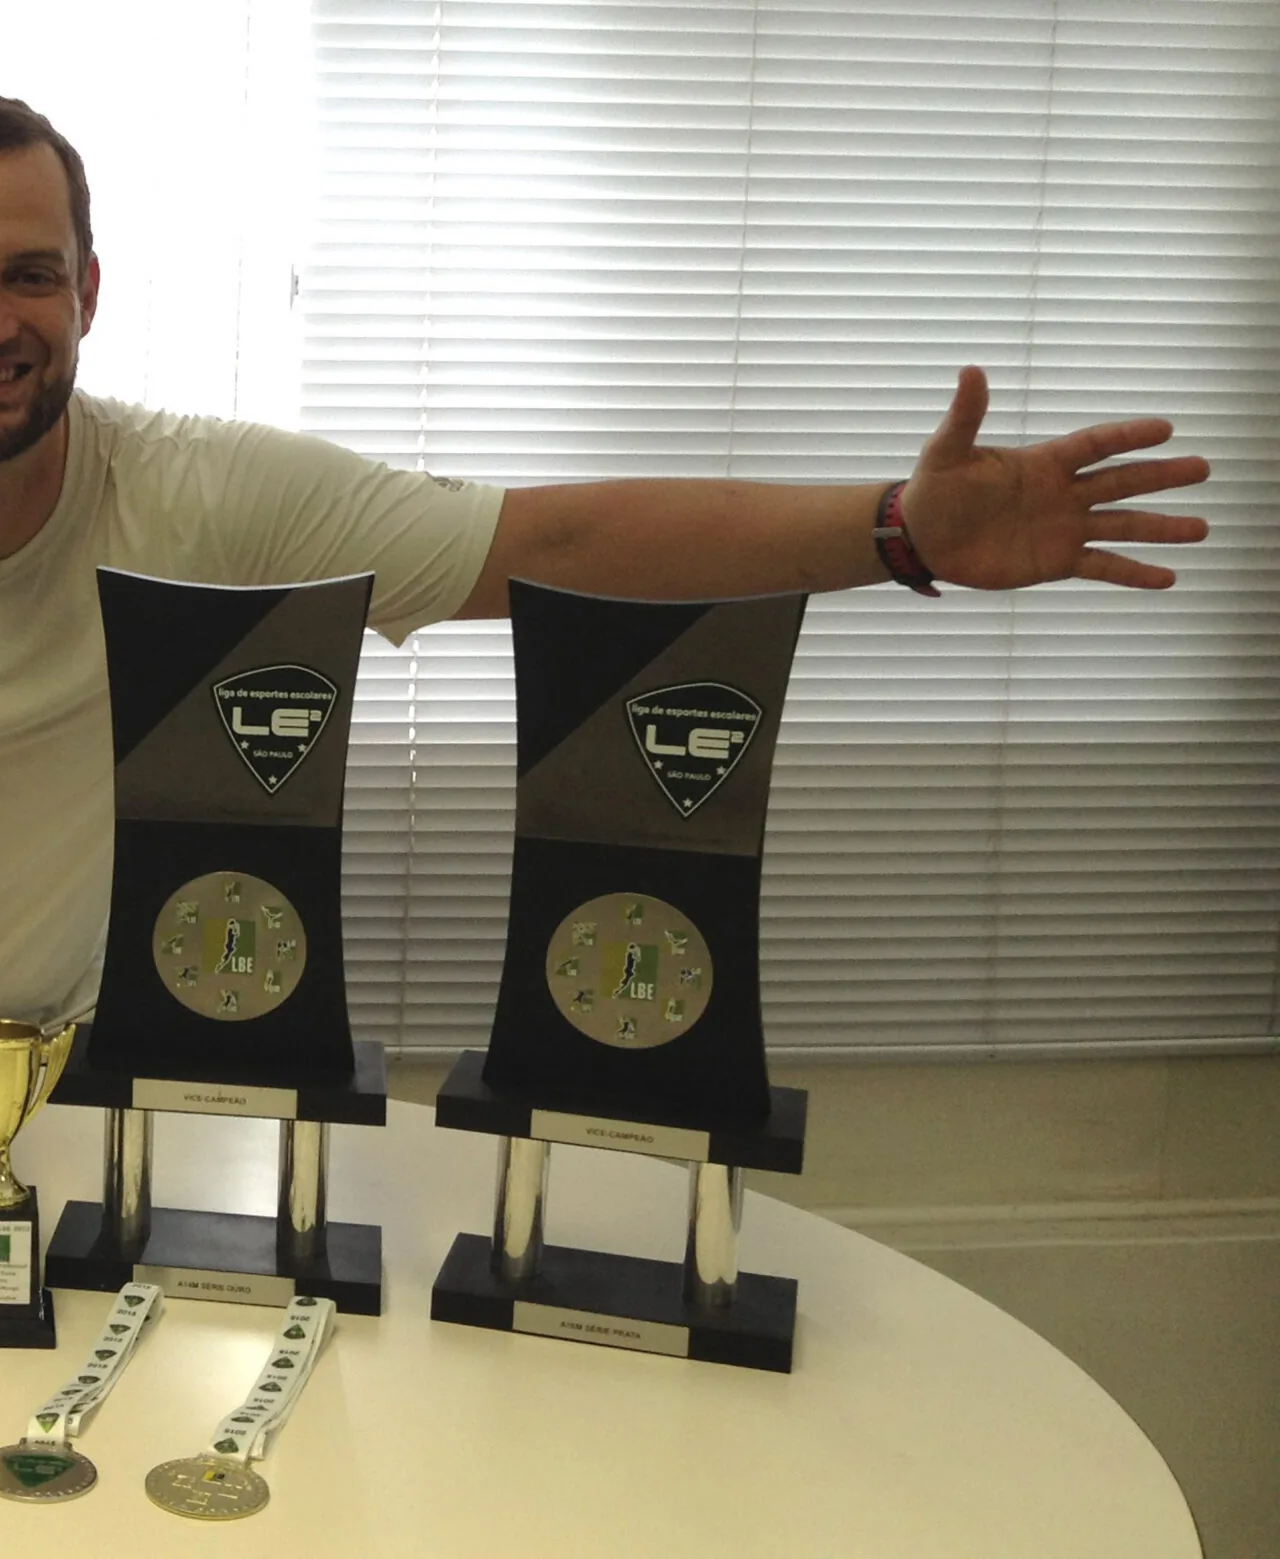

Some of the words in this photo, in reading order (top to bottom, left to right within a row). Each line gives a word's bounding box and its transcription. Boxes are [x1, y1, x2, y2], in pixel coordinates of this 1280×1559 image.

[218, 688, 235, 700] liga
[236, 688, 248, 698] de
[250, 689, 289, 700] esportes
[290, 690, 333, 700] escolares
[651, 705, 664, 715] de
[666, 708, 708, 719] esportes
[253, 749, 268, 758] SÃO
[269, 751, 293, 759] PAULO
[684, 772, 712, 781] PAULO
[231, 957, 253, 973] LBE
[630, 982, 654, 1000] LBE
